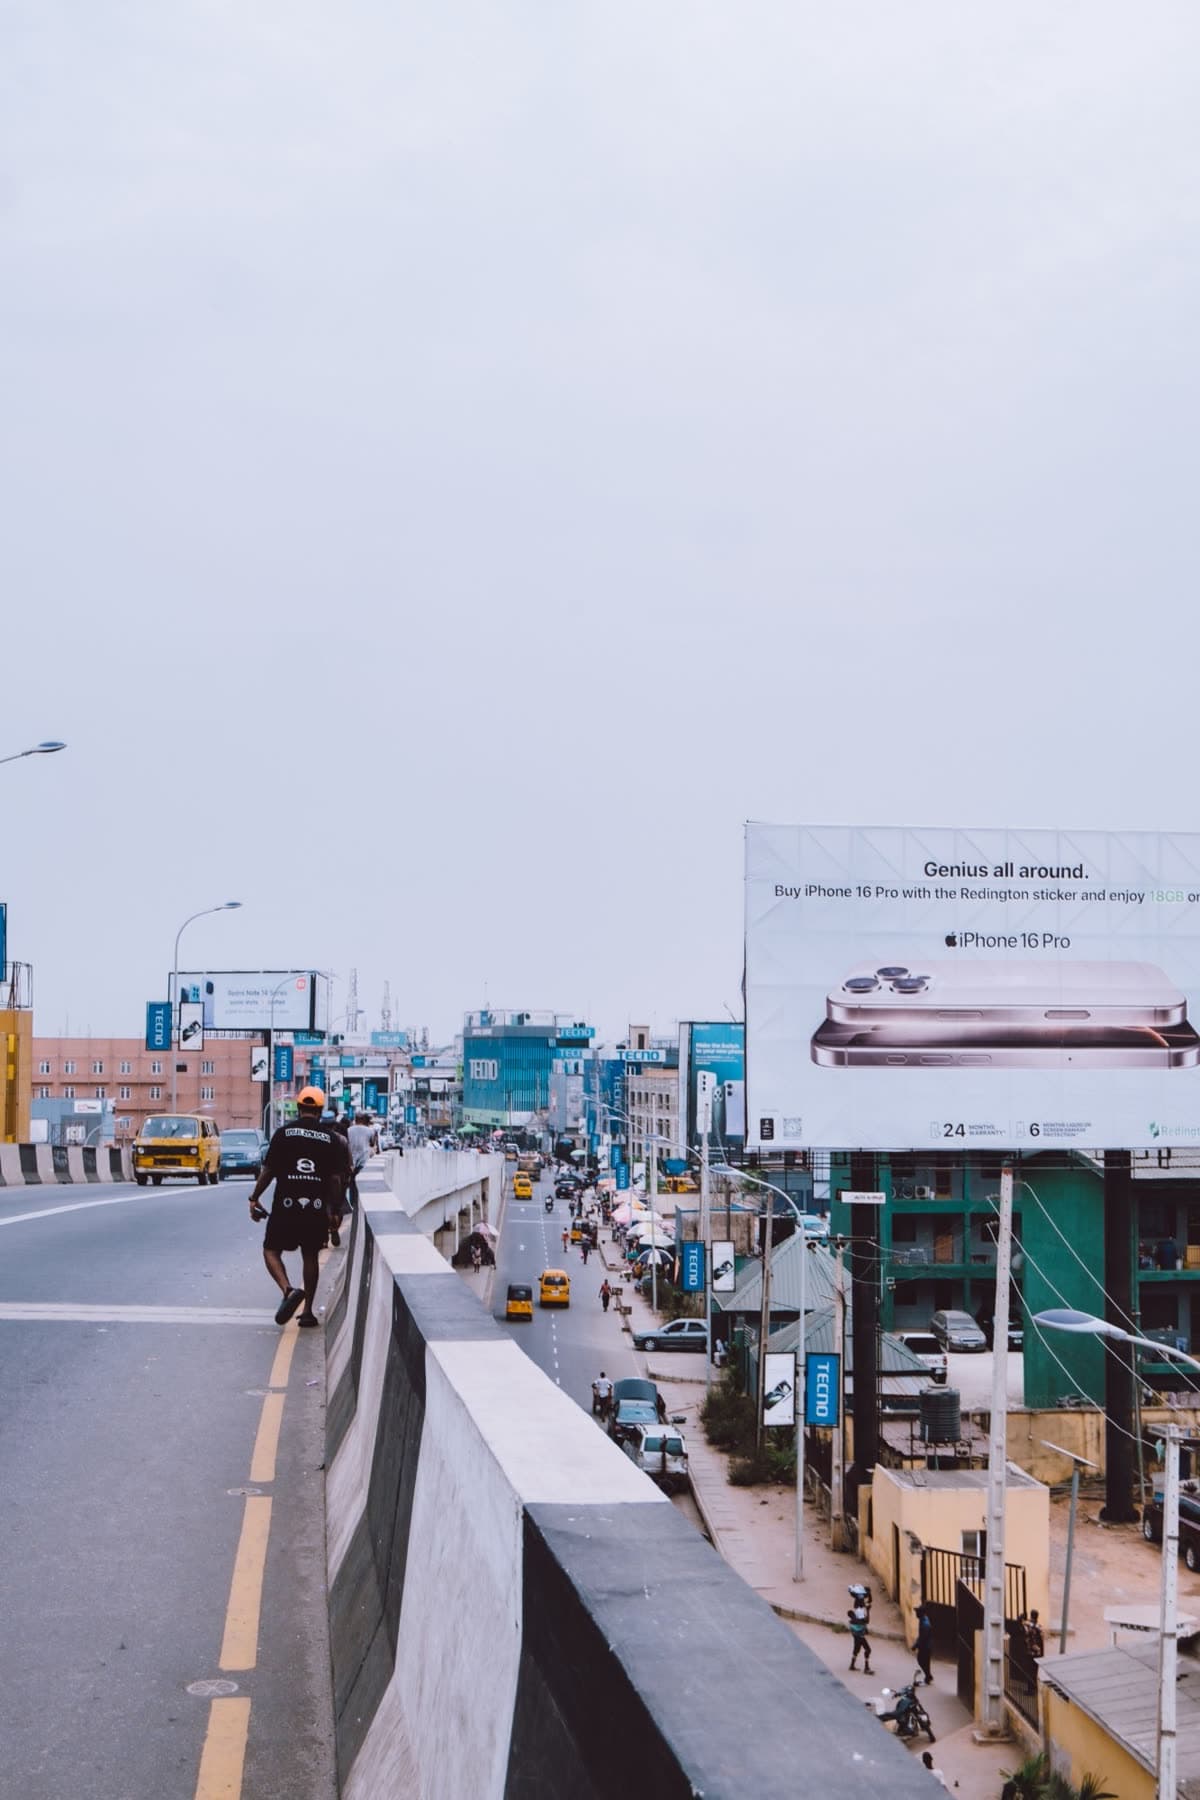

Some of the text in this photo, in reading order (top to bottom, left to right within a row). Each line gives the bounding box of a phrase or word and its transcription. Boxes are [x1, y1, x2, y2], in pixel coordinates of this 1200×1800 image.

[924, 861, 1089, 879] Genius all around.
[774, 884, 801, 899] Buy
[805, 884, 852, 898] iPhone
[856, 886, 872, 898] 16
[875, 886, 899, 899] Pro
[902, 887, 931, 899] with
[934, 888, 957, 900] the
[960, 888, 1029, 903] Redington
[1033, 888, 1077, 901] sticker
[1081, 889, 1106, 902] and
[1109, 889, 1145, 904] enjoy
[1151, 890, 1184, 902] 18GB
[959, 932, 1071, 949] iPhone 16 Pro
[154, 1007, 164, 1046] TECNO
[616, 1050, 660, 1061] TECNO
[943, 1123, 966, 1137] 24
[1029, 1122, 1040, 1137] 6
[689, 1248, 698, 1286] TECNO
[816, 1362, 830, 1418] TECNO
